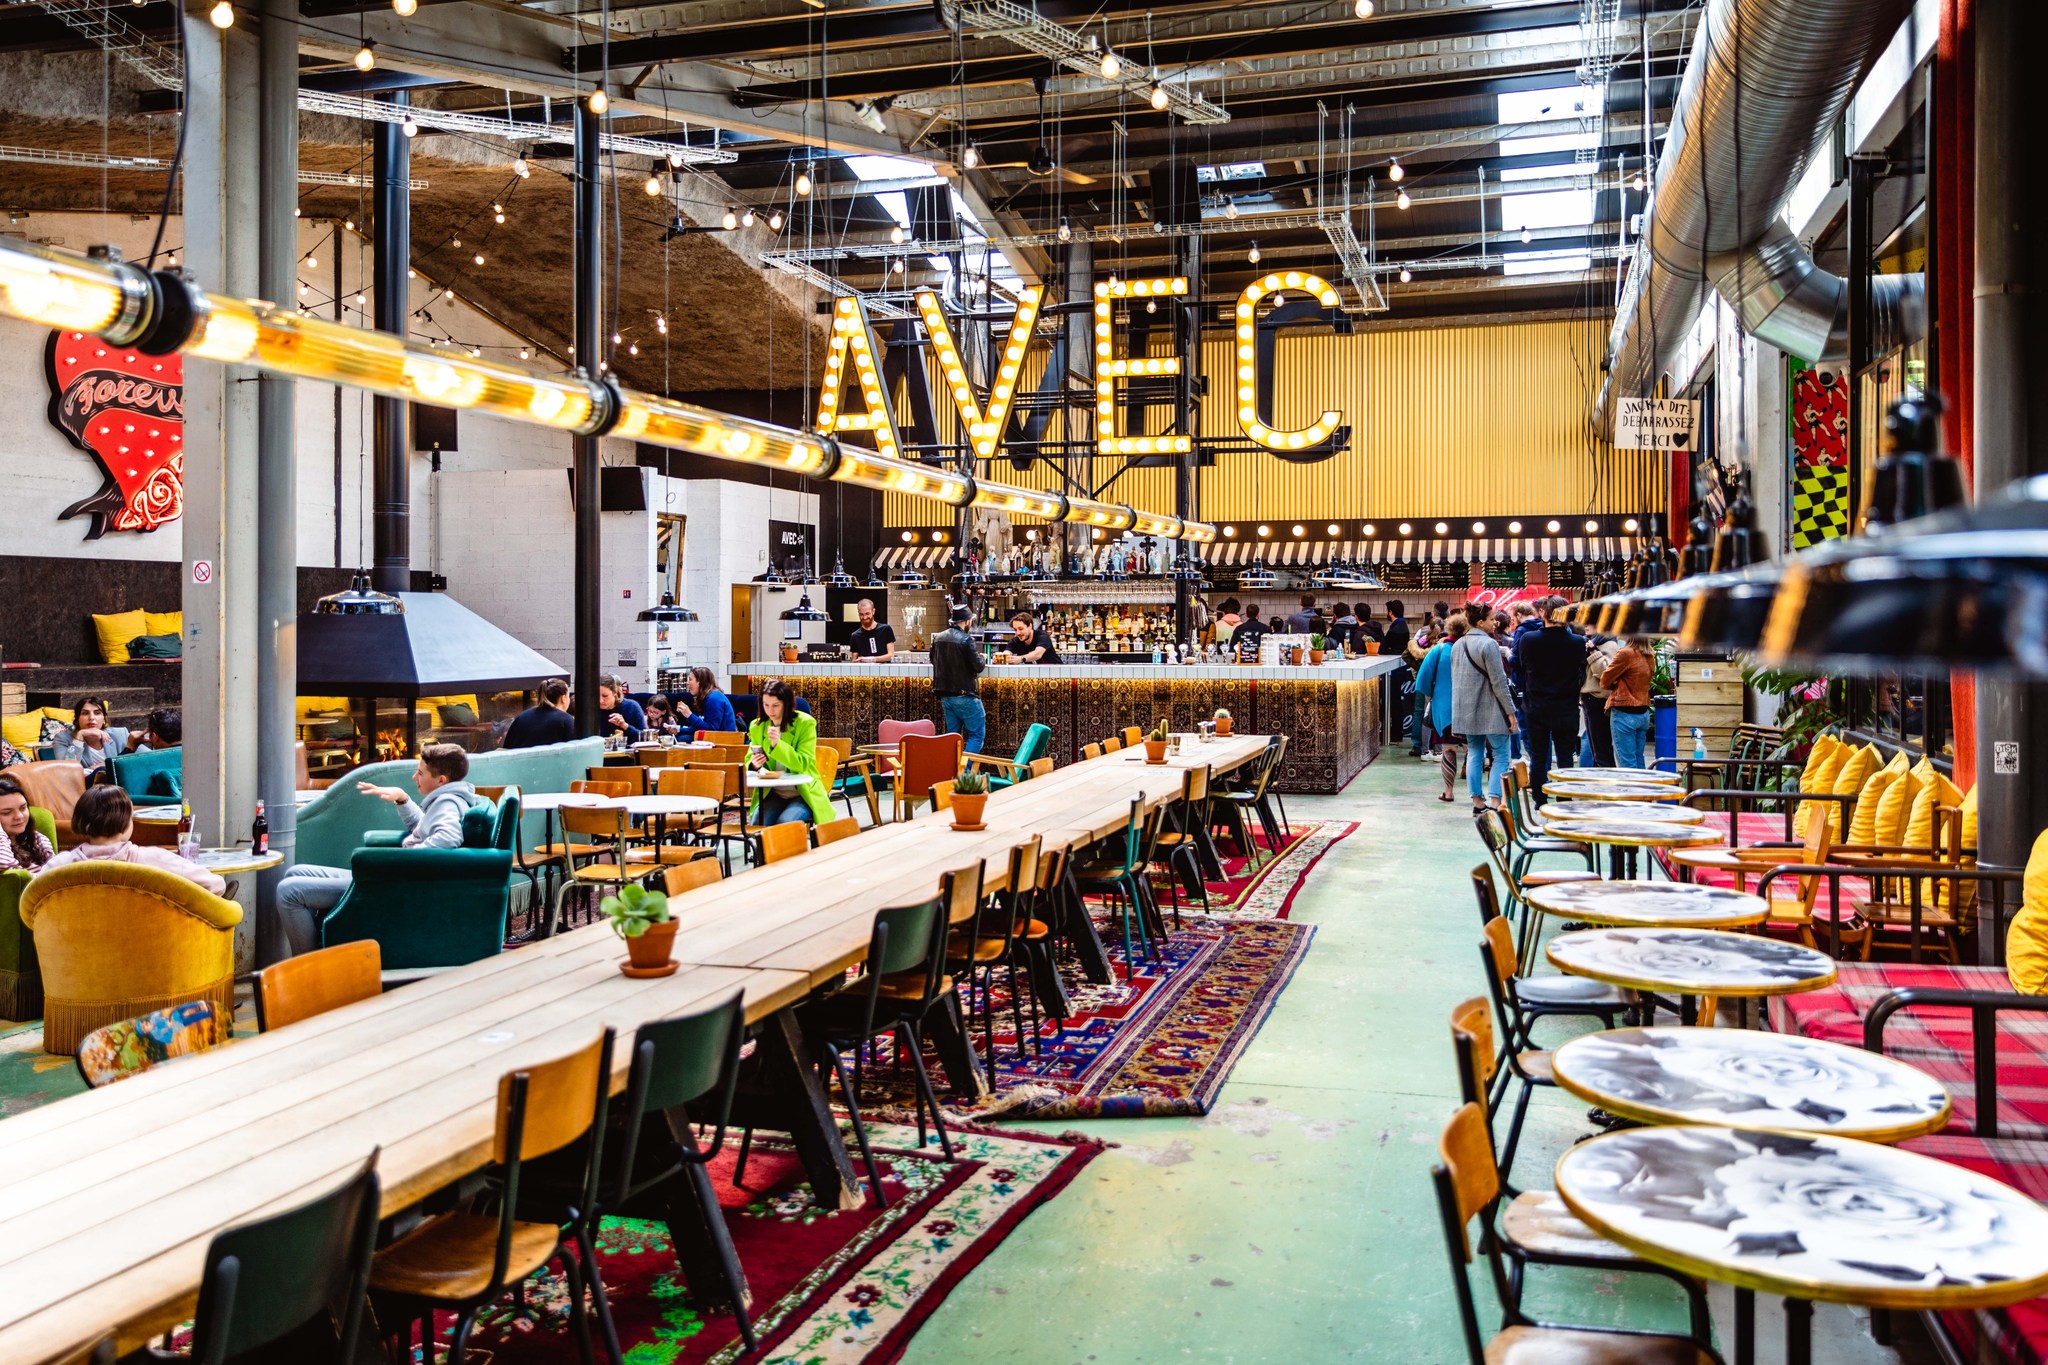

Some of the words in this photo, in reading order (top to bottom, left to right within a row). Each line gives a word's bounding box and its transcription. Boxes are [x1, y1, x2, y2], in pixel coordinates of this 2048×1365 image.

[816, 271, 1343, 459] AVEC
[63, 376, 183, 415] Forev
[1657, 400, 1665, 411] A
[1634, 434, 1670, 446] MERCI
[781, 531, 797, 545] AVEC
[1996, 744, 2017, 753] DISK
